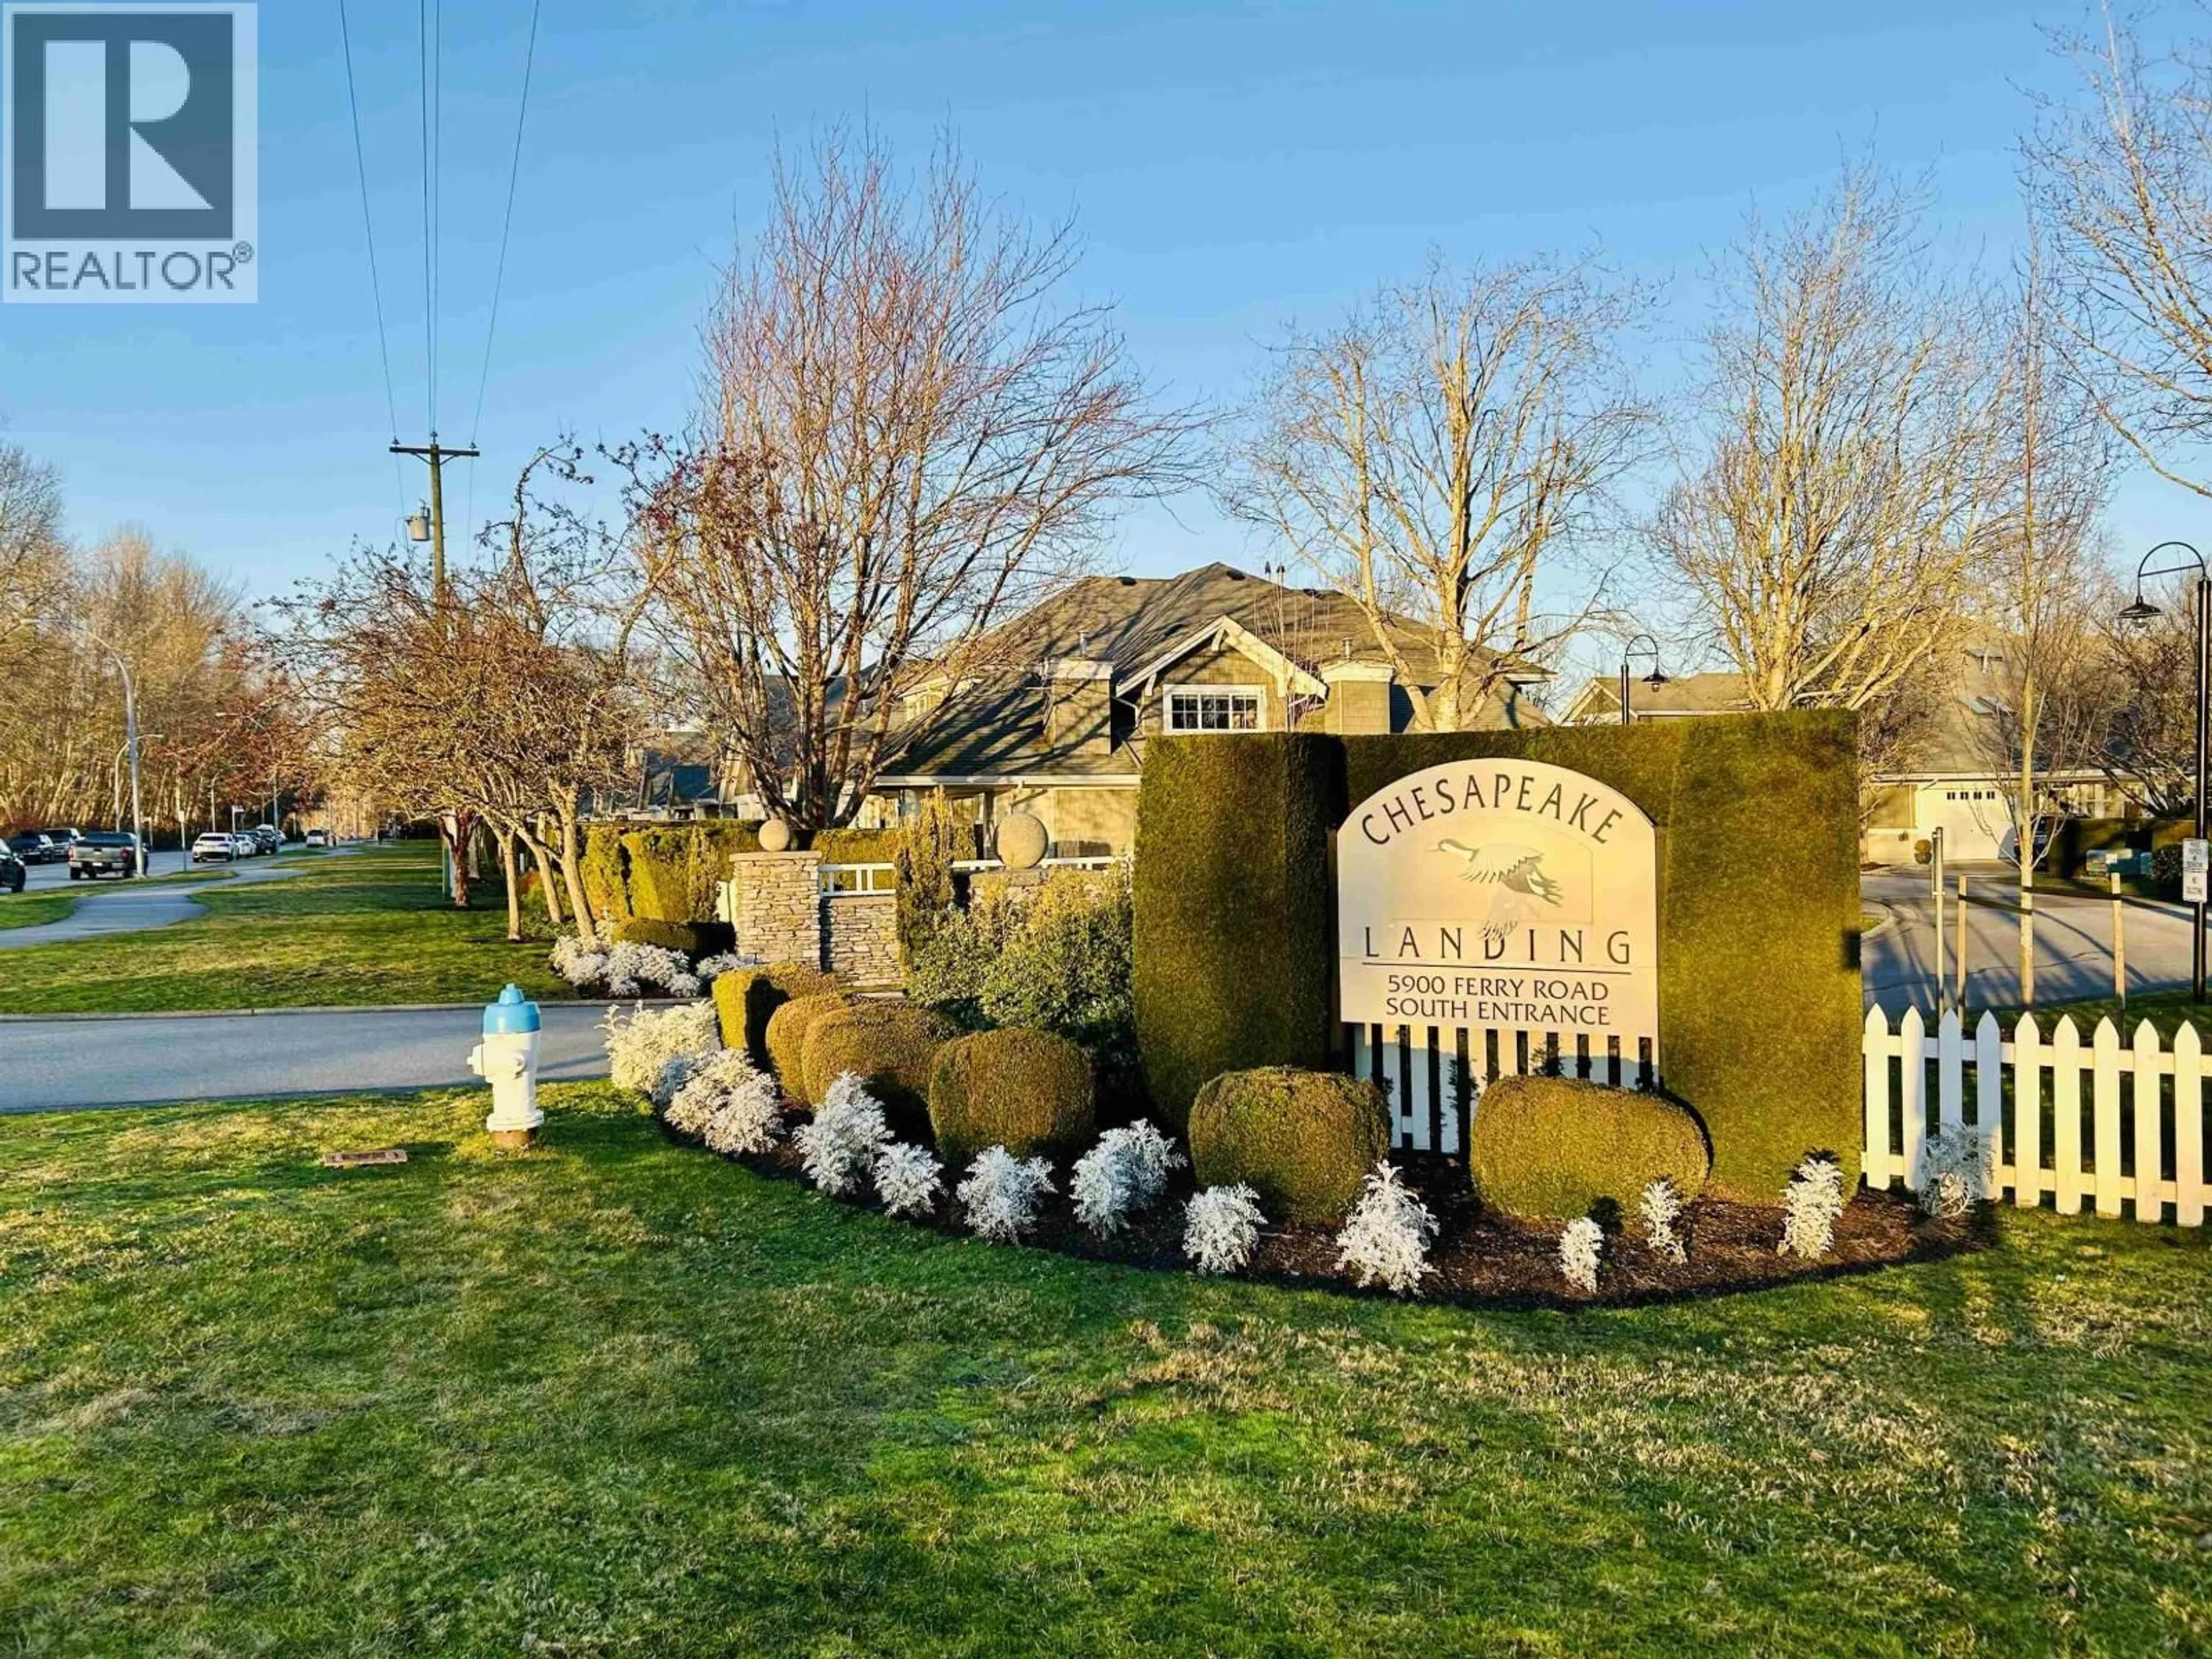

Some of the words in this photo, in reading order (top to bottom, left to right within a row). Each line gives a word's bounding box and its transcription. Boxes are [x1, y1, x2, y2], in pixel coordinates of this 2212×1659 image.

[1361, 774, 1623, 845] CHESAPEAKE
[1365, 926, 1631, 964] LANDING
[1388, 975, 1445, 994] 5900
[1455, 977, 1524, 998] FERRY
[1534, 980, 1608, 1001] ROAD
[1386, 998, 1467, 1019] SOUTH
[1478, 1001, 1610, 1025] ENTRANCE
